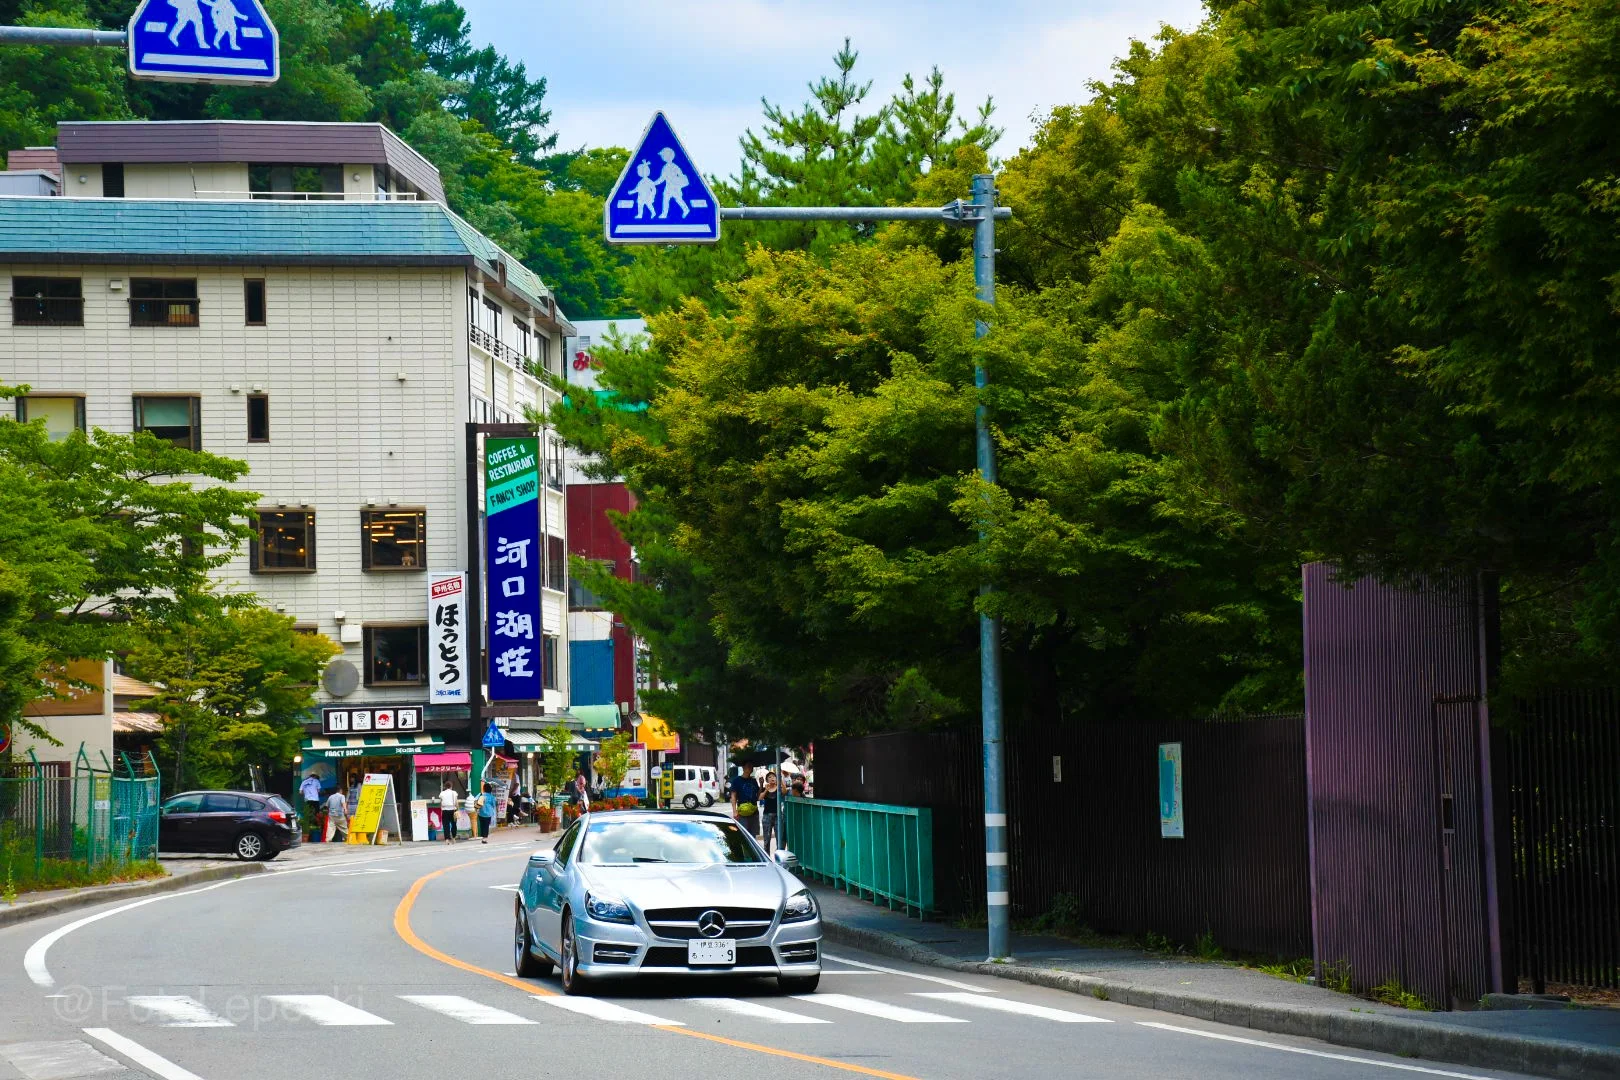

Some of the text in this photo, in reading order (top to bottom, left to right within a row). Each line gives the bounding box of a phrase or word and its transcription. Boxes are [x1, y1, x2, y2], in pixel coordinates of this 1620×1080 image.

[488, 445, 518, 465] COFFEE
[488, 454, 535, 482] RESTAURANT
[489, 480, 536, 507] FANCY SHOP
[433, 581, 460, 595] 甲州名物
[494, 536, 534, 678] 河口湖荘
[435, 602, 460, 685] ほうとう
[345, 749, 364, 757] SHOP
[727, 949, 734, 962] 9
